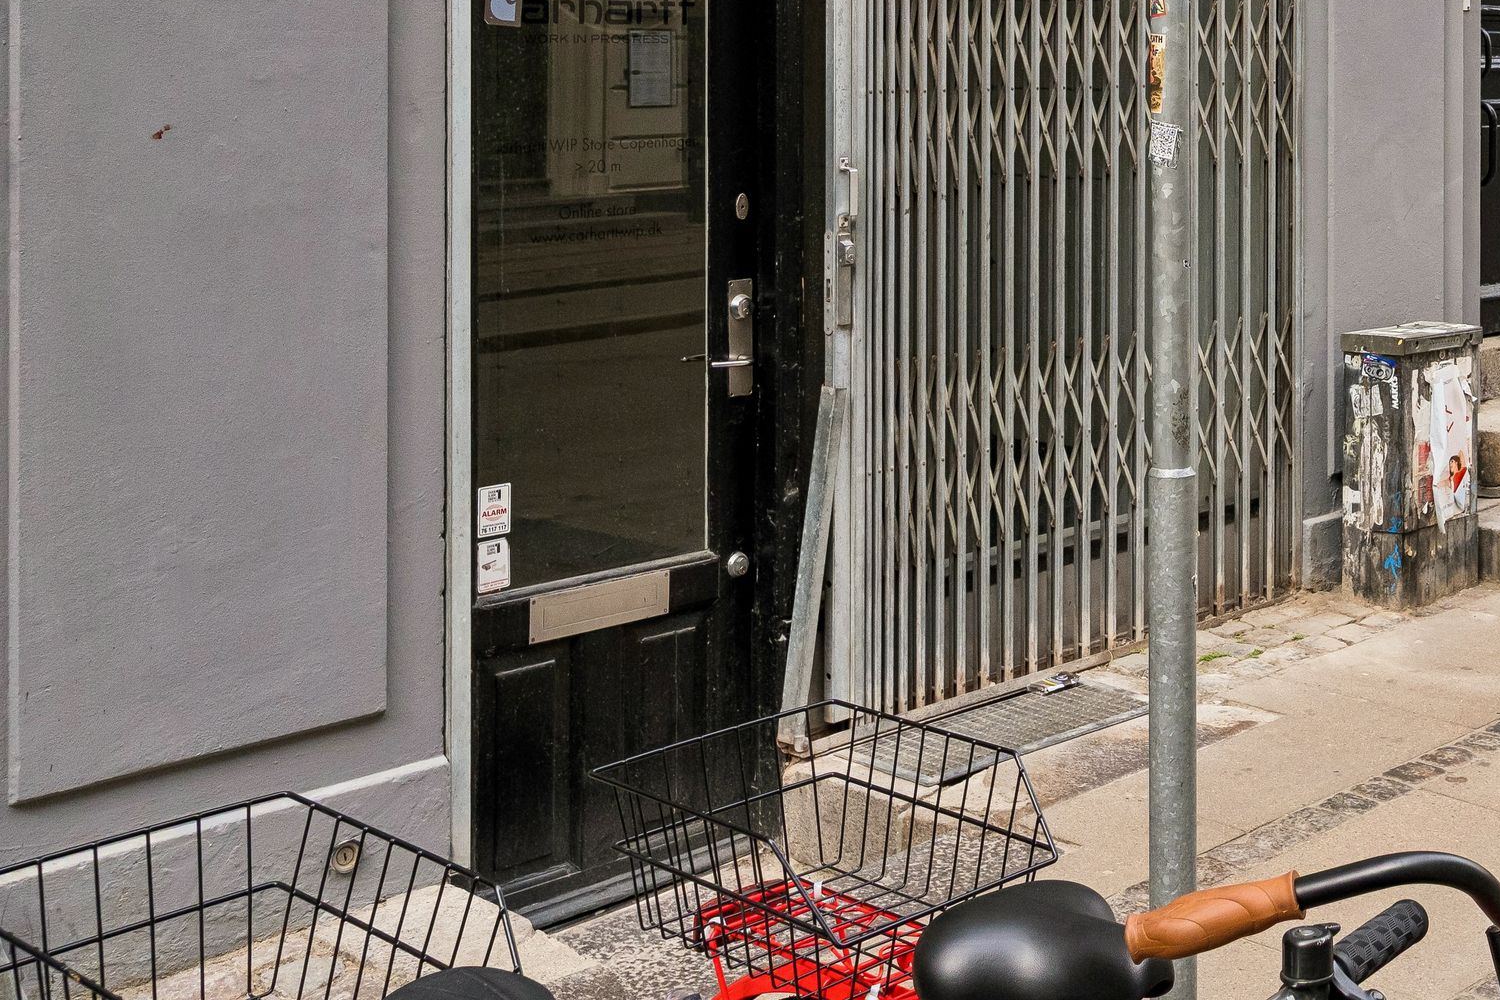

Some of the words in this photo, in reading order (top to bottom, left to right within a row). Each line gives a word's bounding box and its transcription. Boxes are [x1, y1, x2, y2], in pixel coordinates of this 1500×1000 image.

[525, 33, 568, 45] WORK
[573, 33, 587, 45] IN
[582, 137, 615, 151] Store
[589, 159, 606, 173] 20
[611, 163, 622, 173] m
[559, 204, 602, 219] Online
[606, 206, 637, 218] store
[482, 508, 507, 518] ALARM
